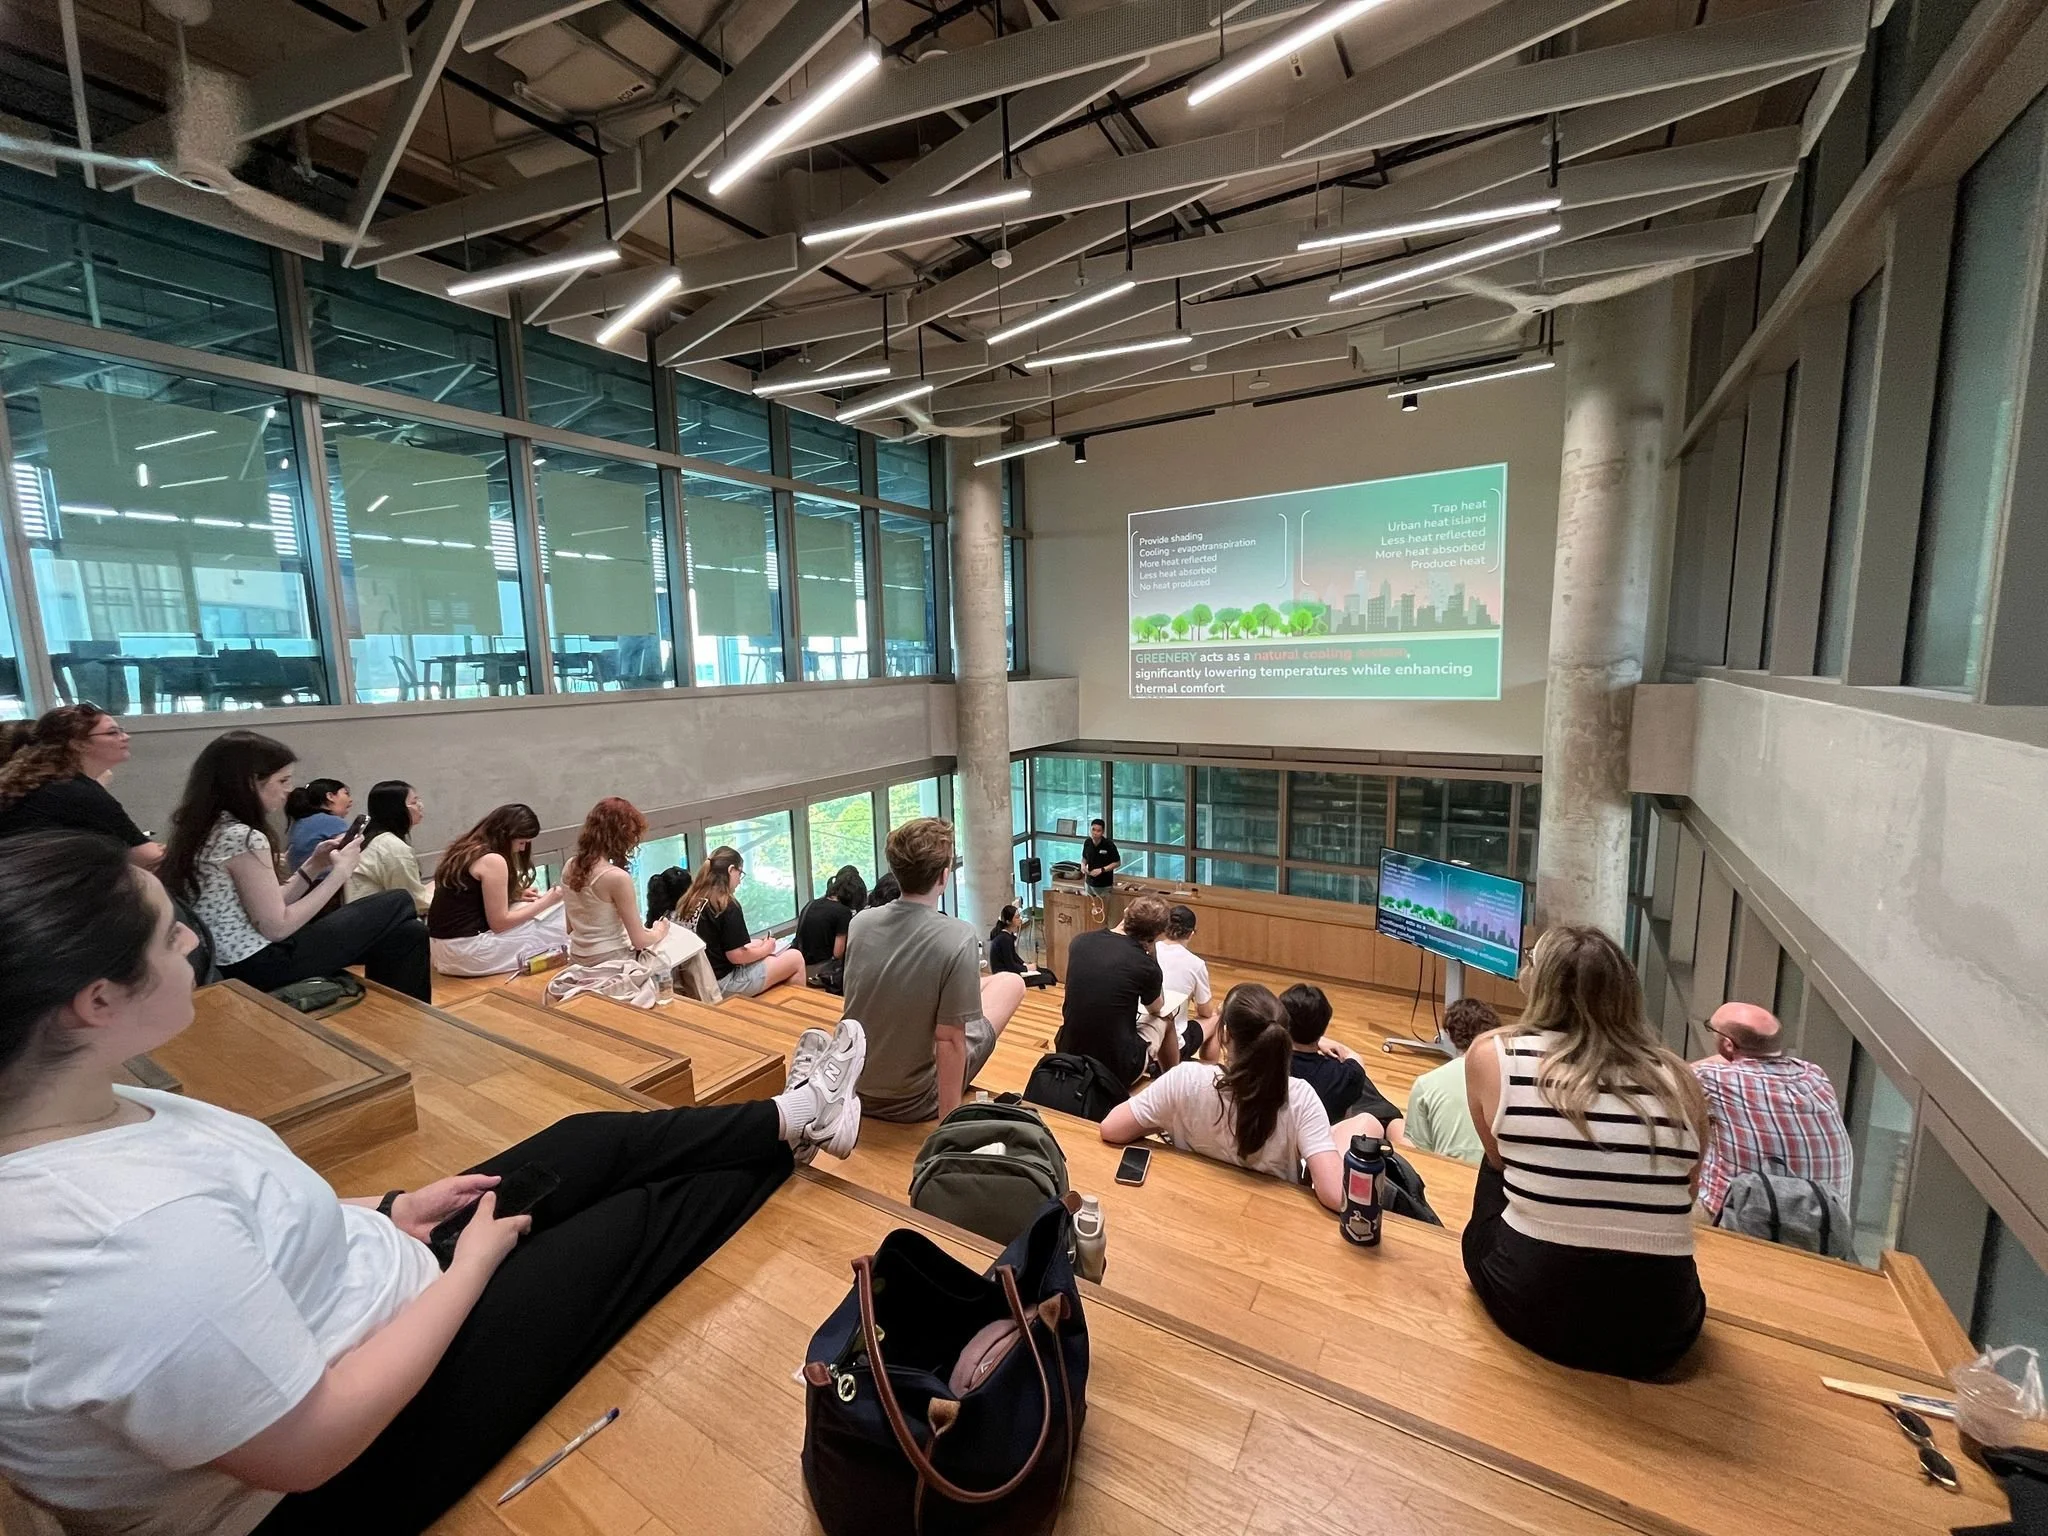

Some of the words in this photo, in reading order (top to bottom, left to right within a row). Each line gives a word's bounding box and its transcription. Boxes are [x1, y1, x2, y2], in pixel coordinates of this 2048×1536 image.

[1432, 503, 1457, 513] Trap
[1461, 500, 1487, 510] heat
[1388, 521, 1420, 532] Urban
[1424, 518, 1449, 528] heat
[1451, 513, 1486, 525] island
[1139, 537, 1169, 546] Provide
[1171, 532, 1203, 543] shading
[1381, 536, 1405, 546] Less
[1408, 533, 1433, 543] heat
[1436, 527, 1486, 541] reflected
[1139, 547, 1170, 557] Cooling
[1177, 538, 1256, 554] evapotranspiration
[1375, 550, 1402, 559] More
[1405, 547, 1429, 557] heat
[1432, 541, 1486, 554] absorbed
[1139, 560, 1160, 569] More
[1161, 557, 1180, 566] heat
[1181, 554, 1217, 565] reflected
[1411, 559, 1456, 570] Produce
[1460, 556, 1486, 566] heat
[1139, 572, 1157, 580] Less
[1159, 570, 1176, 578] heat
[1178, 565, 1217, 577] absorbed
[1139, 583, 1151, 591] No
[1152, 580, 1170, 589] heat
[1172, 578, 1210, 590] produced
[1135, 652, 1197, 664] GREENERY
[1200, 652, 1223, 662] acts
[1227, 653, 1240, 662] as
[1243, 653, 1250, 661] a
[1254, 649, 1299, 661] natural
[1135, 667, 1201, 681] significantly
[1204, 666, 1257, 680] lowering
[1260, 665, 1348, 678] temperatures
[1351, 663, 1391, 676] while
[1395, 662, 1473, 677] enhancing
[1135, 683, 1177, 694] thermal
[1180, 683, 1225, 694] comfort
